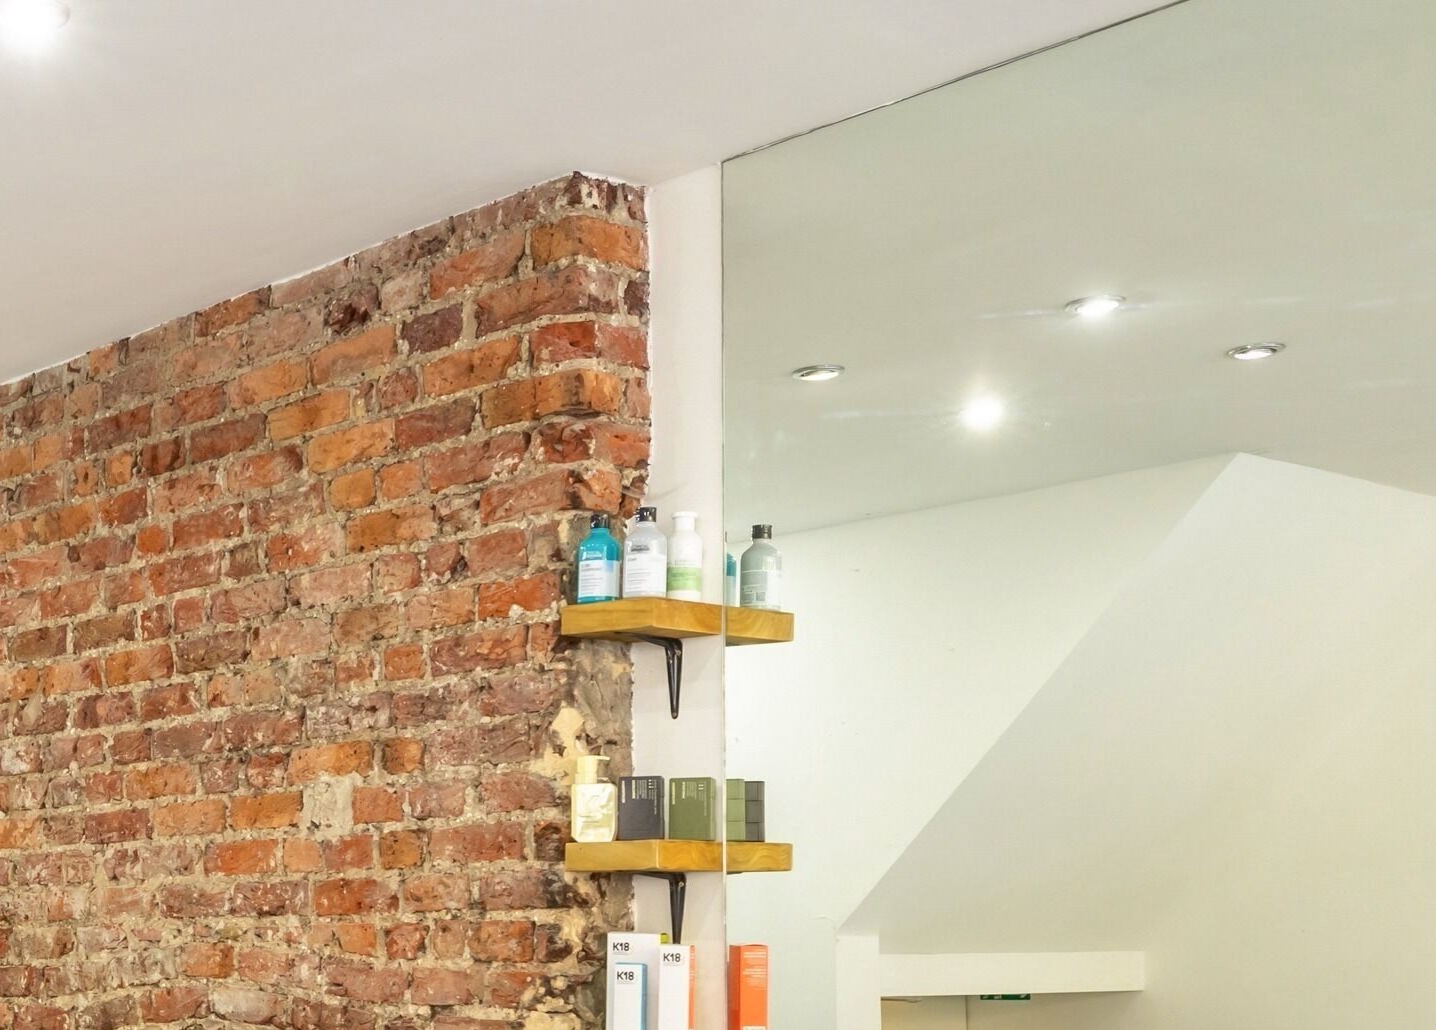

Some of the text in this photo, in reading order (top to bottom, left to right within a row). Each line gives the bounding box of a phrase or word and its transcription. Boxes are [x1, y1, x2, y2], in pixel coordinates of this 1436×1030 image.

[612, 942, 630, 951] K18
[663, 953, 681, 962] K18
[616, 971, 635, 981] K18
